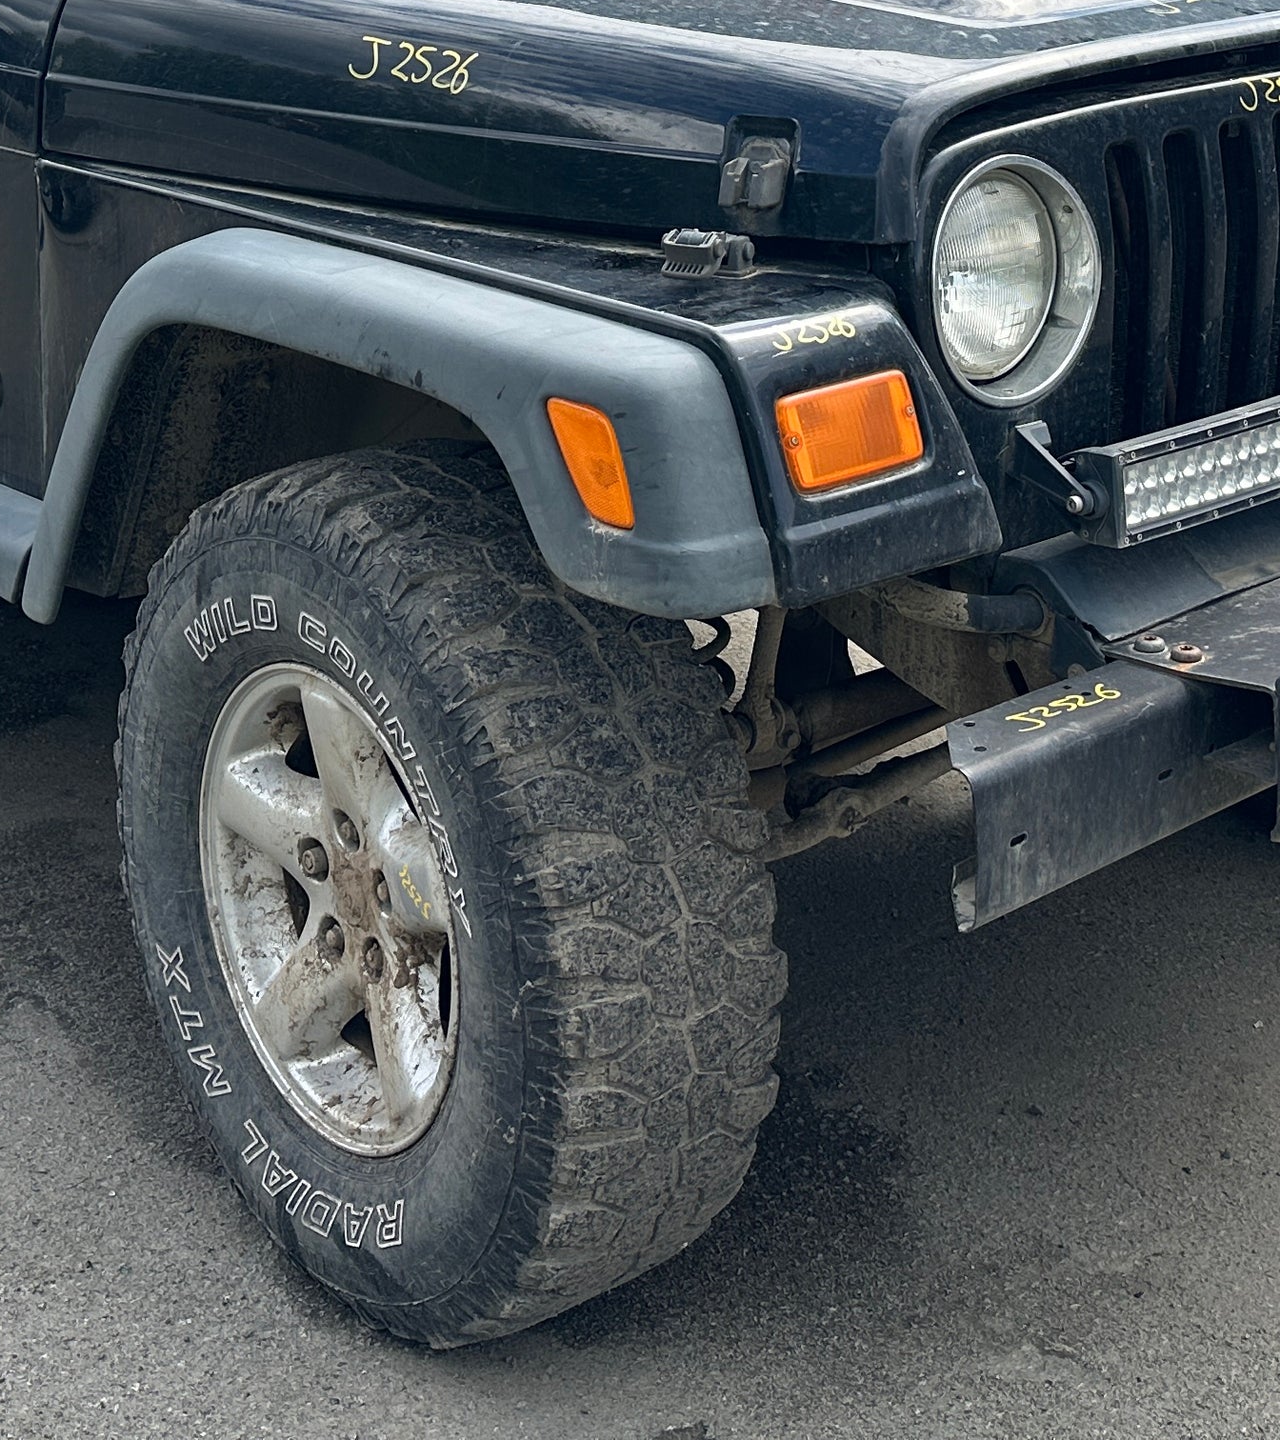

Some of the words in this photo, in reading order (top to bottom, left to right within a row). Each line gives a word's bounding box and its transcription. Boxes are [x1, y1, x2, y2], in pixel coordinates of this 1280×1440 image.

[348, 35, 479, 95] J2526
[184, 594, 279, 662] WILD
[297, 610, 473, 939] COUNTRY
[1004, 683, 1121, 733] J2526
[155, 942, 233, 1098] MTX
[240, 1118, 404, 1249] RADIAL
